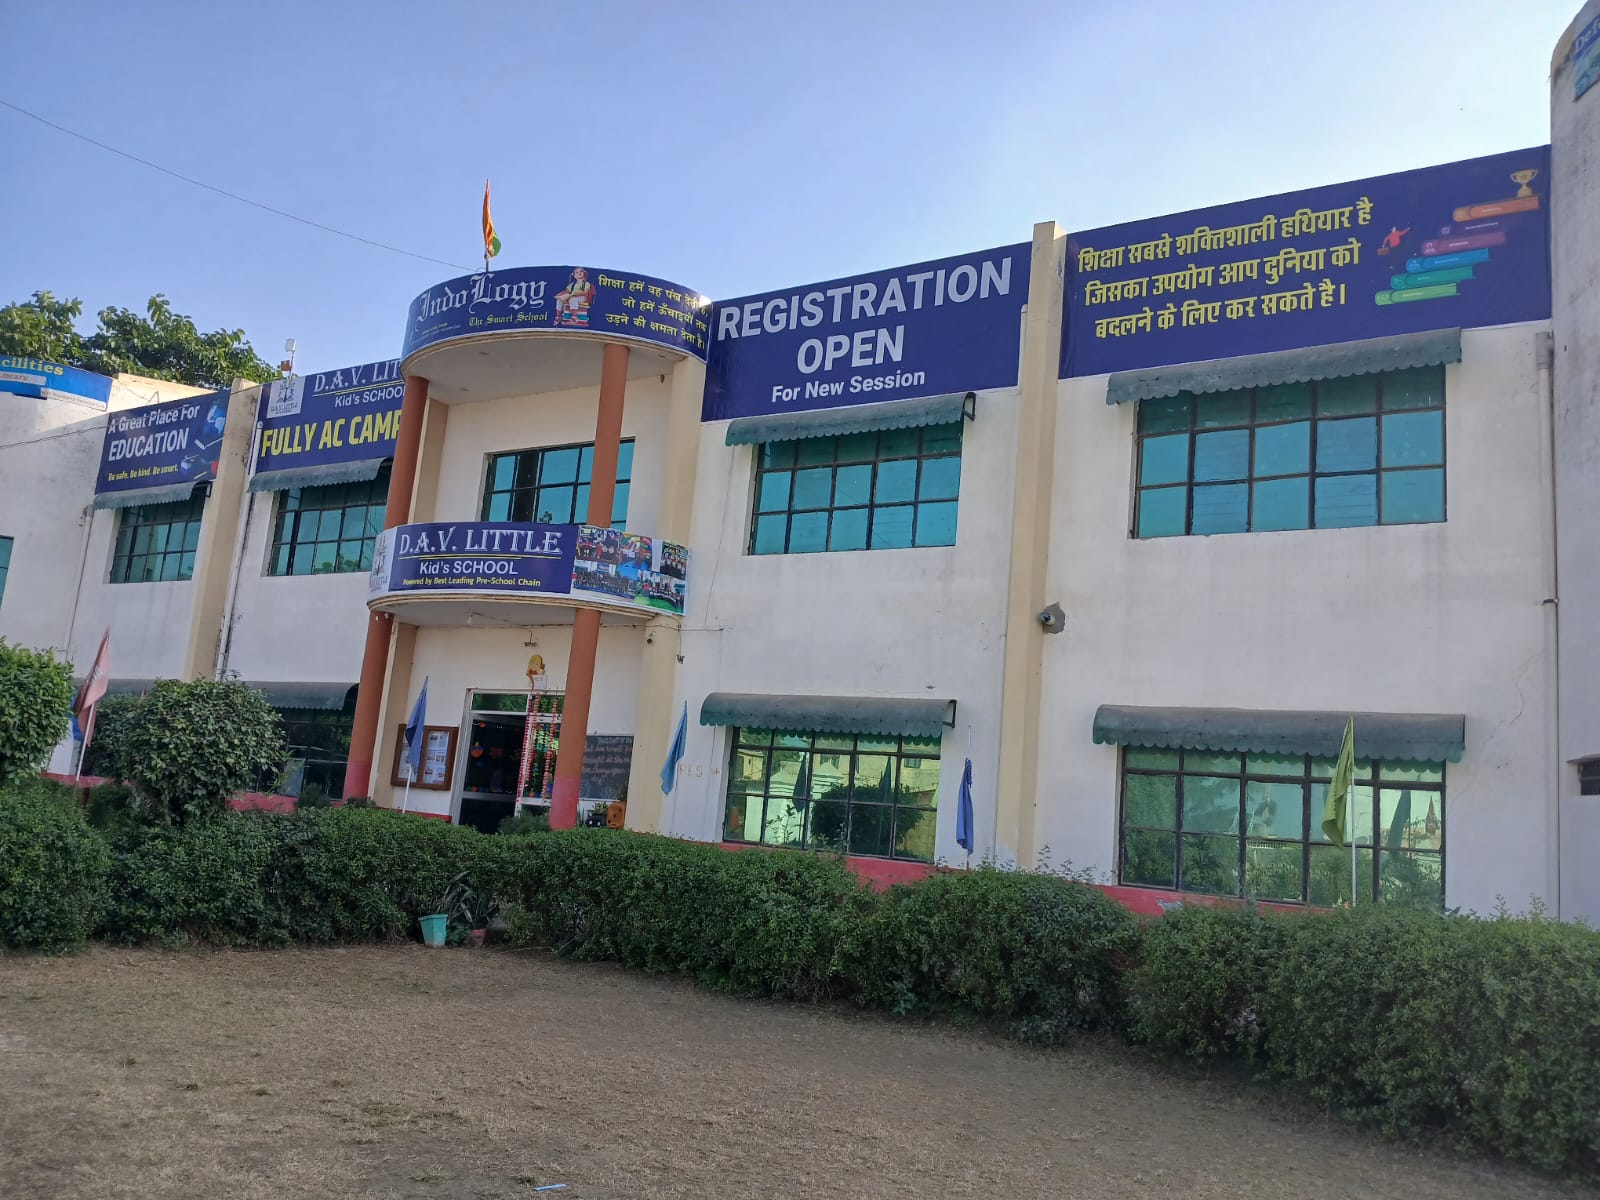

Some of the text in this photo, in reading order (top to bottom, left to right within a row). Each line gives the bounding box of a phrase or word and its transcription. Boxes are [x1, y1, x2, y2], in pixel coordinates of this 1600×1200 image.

[1078, 246, 1125, 273] शिक्षा
[1128, 233, 1173, 264] सबसे
[1175, 215, 1277, 257] शक्तिशाली
[1355, 196, 1374, 225] है
[598, 274, 625, 289] शिक्षा
[629, 280, 645, 292] हमें
[648, 285, 663, 297] वह
[1085, 237, 1361, 306] जिसका उपयोग आप दुनिया को
[622, 296, 636, 308] जो
[640, 300, 655, 312] हमें
[717, 256, 1012, 342] REGISTRATION
[1095, 304, 1153, 339] बदलने
[1157, 303, 1178, 330] के
[1181, 298, 1221, 327] लिए
[1224, 298, 1257, 320] कर
[1261, 283, 1315, 316] सकते
[486, 314, 513, 325] Smart
[515, 312, 548, 324] School
[605, 313, 629, 326] उड़ने
[633, 316, 646, 328] की
[650, 321, 678, 336] क्षमता
[797, 325, 905, 374] OPEN
[0, 355, 64, 376] cilities
[0, 371, 28, 382] ibrary
[313, 360, 401, 393] D.A.V. LIT
[772, 369, 926, 403] For New Session
[334, 394, 360, 408] Kid's
[108, 404, 200, 434] A Great Place For
[261, 409, 402, 457] FULLY AC CAMP
[108, 427, 190, 462] EDUCATION
[399, 526, 563, 555] D.A.V. LITTLE
[403, 576, 541, 587] Powered by Best Leading Pre-School Chain
[419, 560, 518, 575] Kid's SCHOOL
